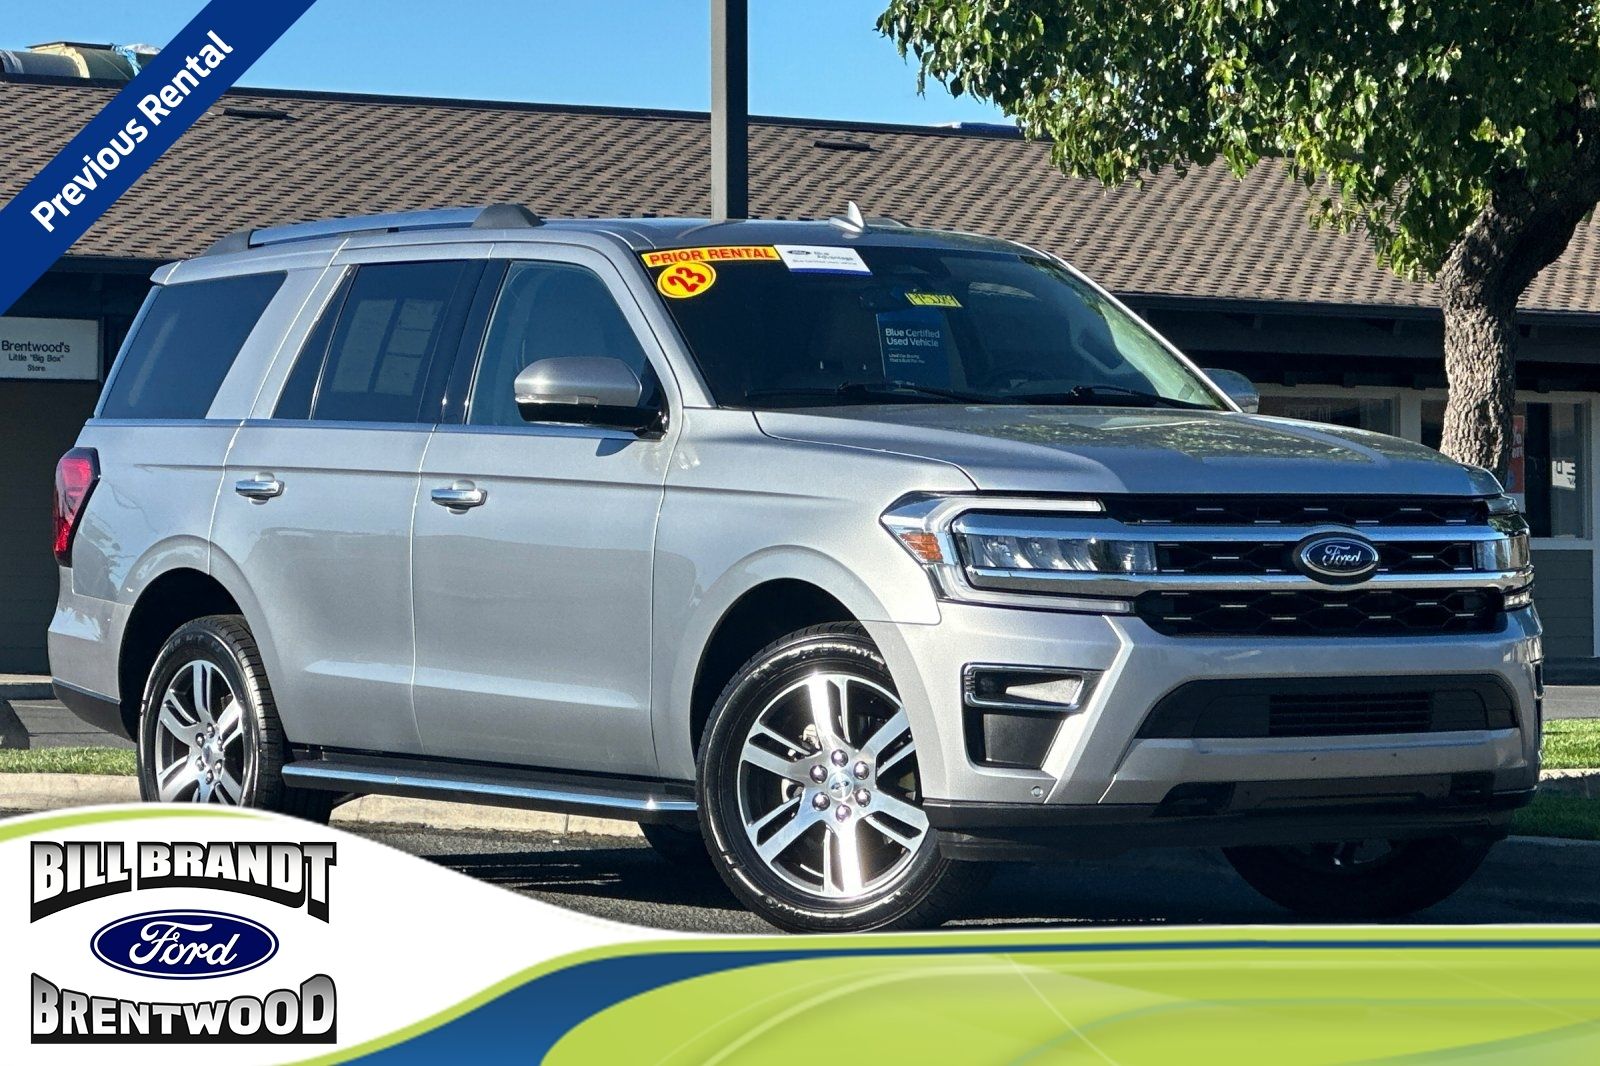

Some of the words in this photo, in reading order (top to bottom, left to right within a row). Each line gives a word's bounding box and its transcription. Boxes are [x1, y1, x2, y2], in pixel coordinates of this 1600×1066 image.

[649, 249, 704, 265] PRIOR
[707, 248, 775, 259] RENTAL
[667, 266, 706, 292] 23
[885, 328, 904, 337] Blue
[906, 328, 940, 338] Certified
[2, 340, 70, 353] Brentwood's
[886, 337, 909, 346] Used
[910, 337, 939, 347] Vehicle
[9, 353, 27, 362] Little
[30, 353, 44, 363] "Big
[28, 364, 46, 372] Store
[1322, 544, 1361, 567] Ford
